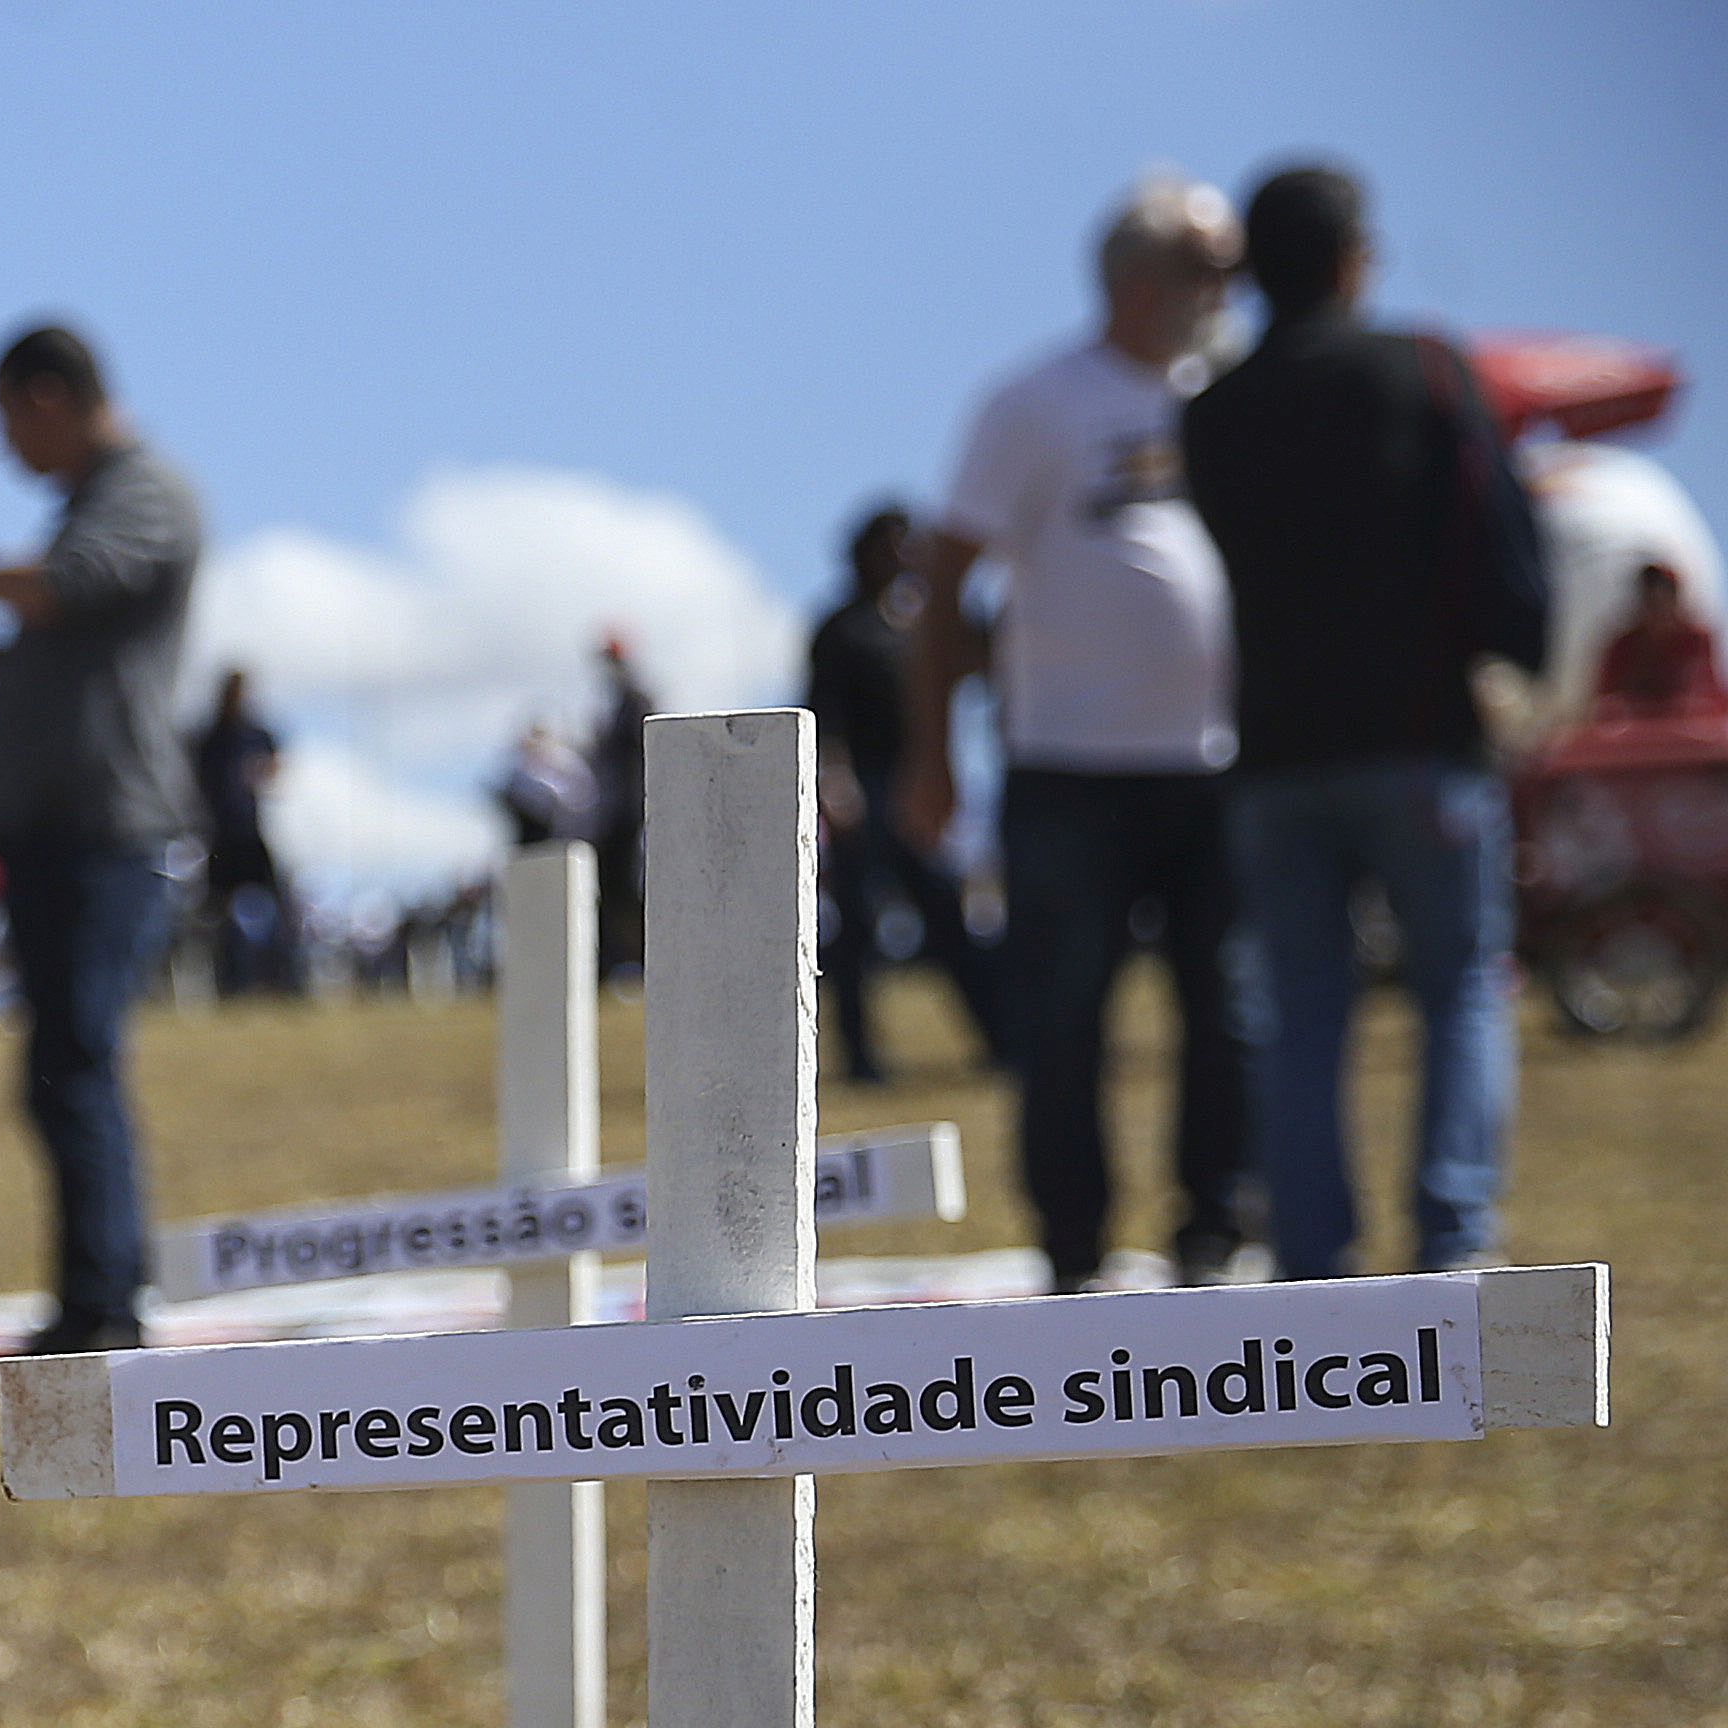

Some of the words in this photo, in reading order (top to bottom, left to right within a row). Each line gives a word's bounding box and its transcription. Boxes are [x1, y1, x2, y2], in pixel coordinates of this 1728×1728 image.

[212, 1187, 592, 1283] Progressão
[154, 1357, 1036, 1481] Representatividade
[1062, 1327, 1442, 1424] sindical
